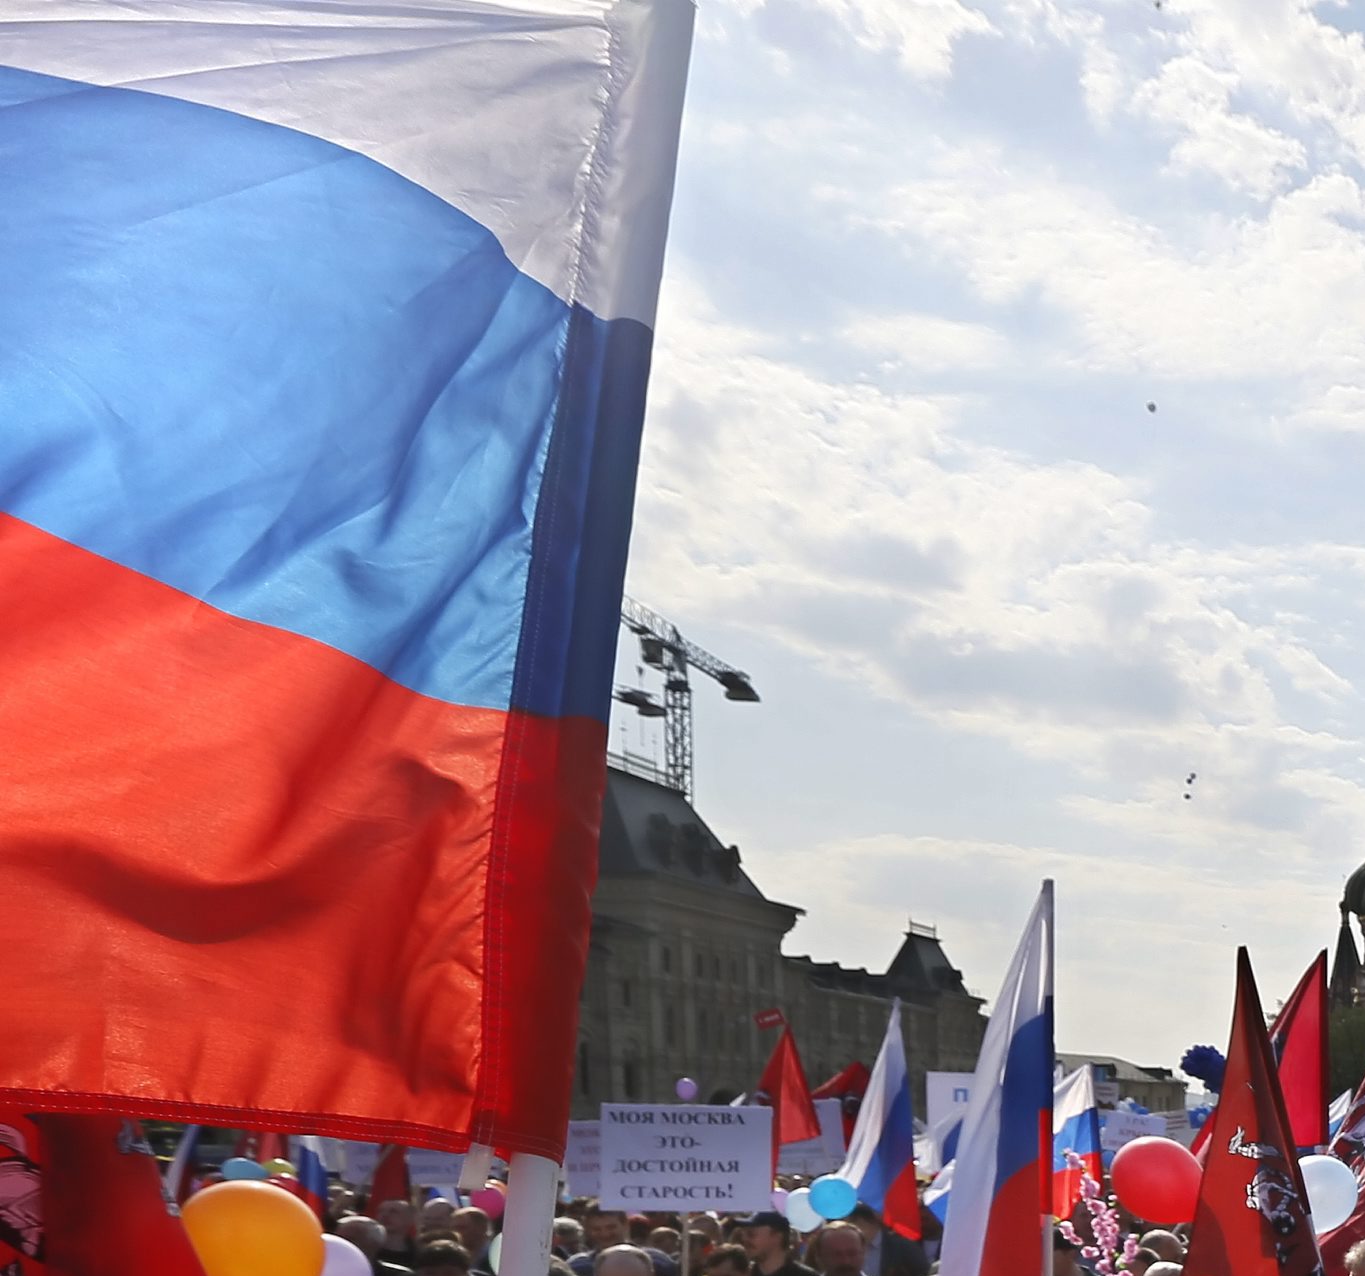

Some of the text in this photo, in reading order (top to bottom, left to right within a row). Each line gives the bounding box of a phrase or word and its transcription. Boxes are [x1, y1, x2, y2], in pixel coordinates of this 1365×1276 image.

[608, 1111, 746, 1125] МОЯ МОСКВА
[655, 1135, 703, 1148] ЭТО-
[612, 1157, 740, 1174] ДОСТОЙНАЯ
[620, 1183, 733, 1199] СТАРОСТЬ!
